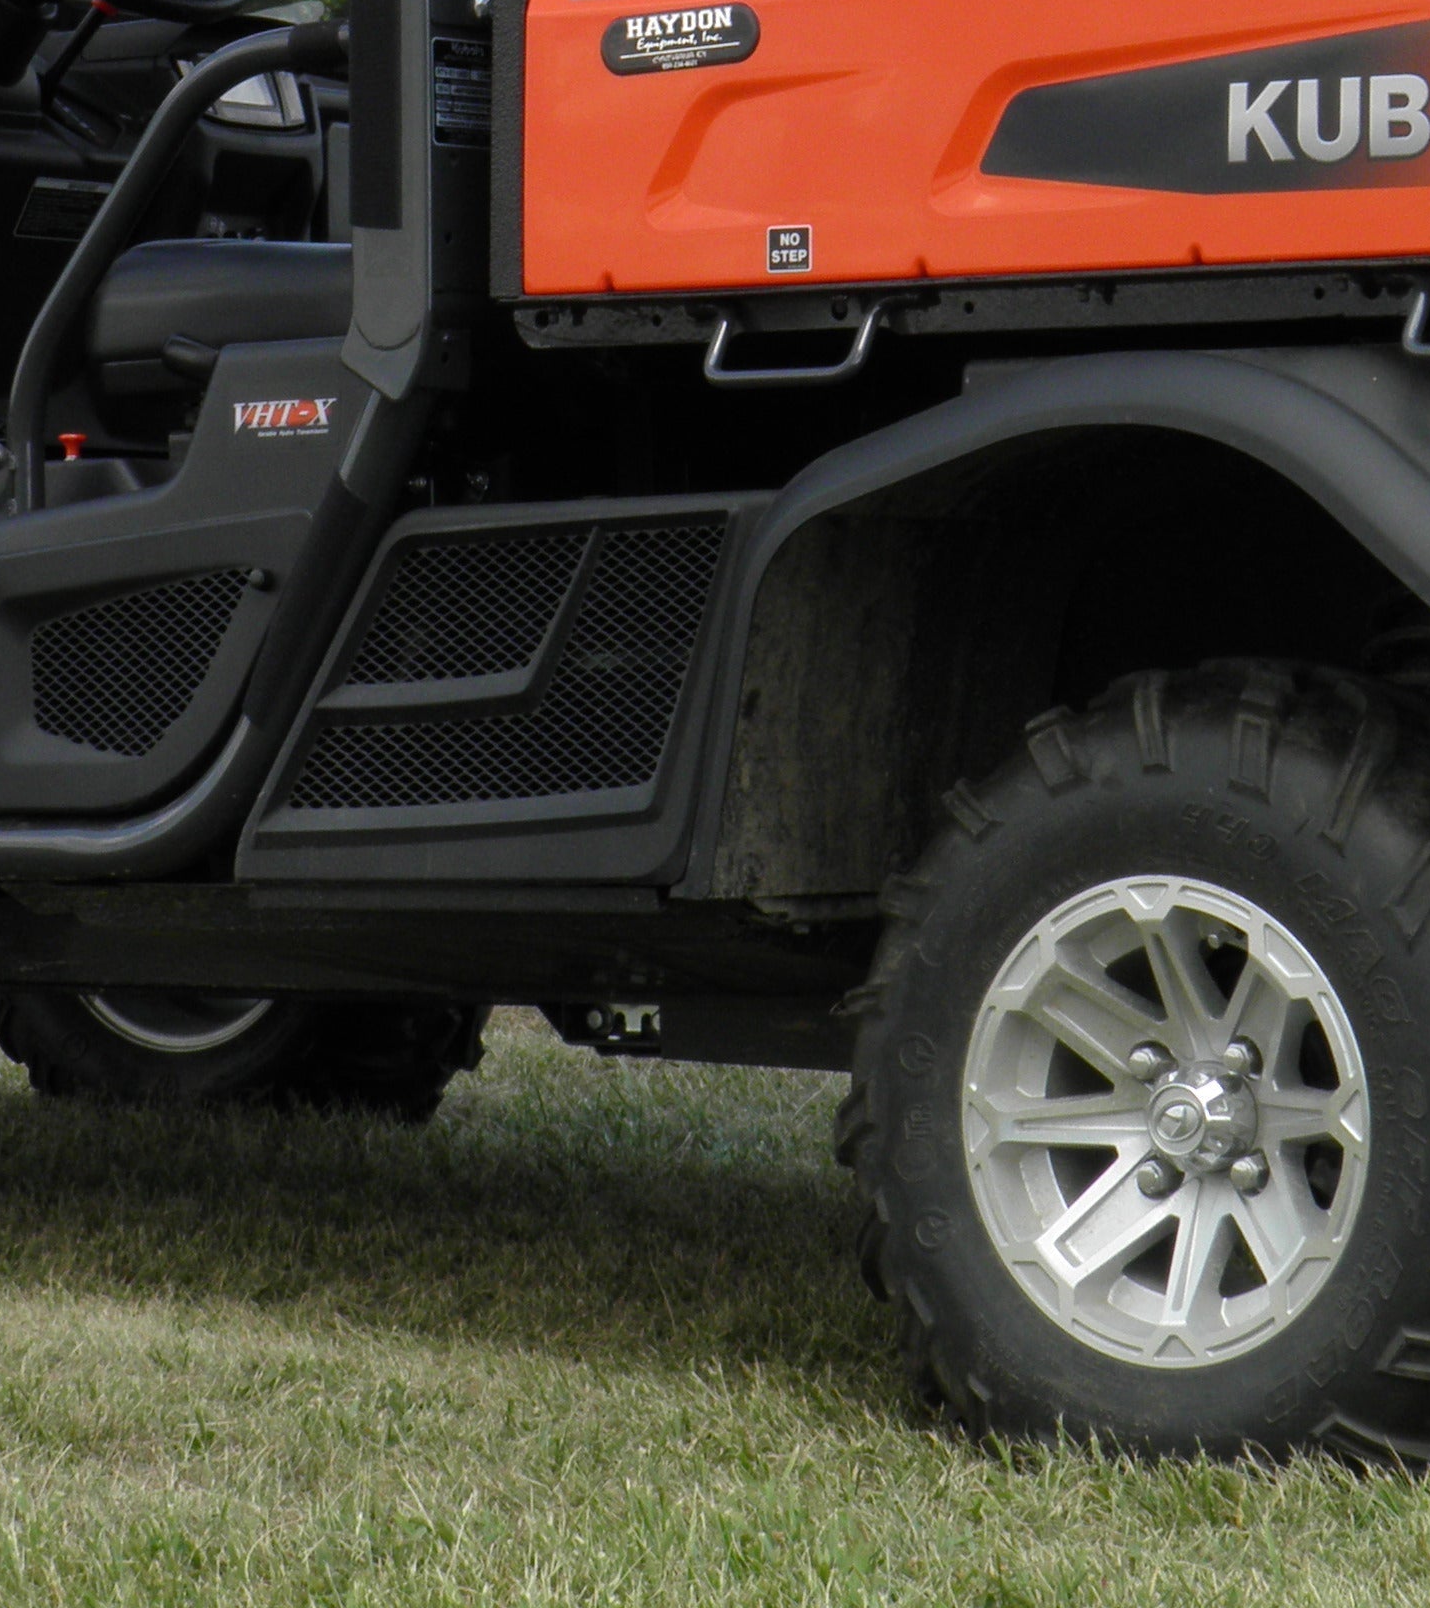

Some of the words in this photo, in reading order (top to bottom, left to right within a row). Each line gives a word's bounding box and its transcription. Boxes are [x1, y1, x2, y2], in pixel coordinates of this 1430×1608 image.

[626, 6, 732, 39] HAYDON
[637, 33, 697, 52] Equipment,
[702, 31, 722, 42] Inc.
[780, 232, 800, 246] NO
[771, 249, 807, 263] STEP
[233, 397, 337, 434] VHT-X
